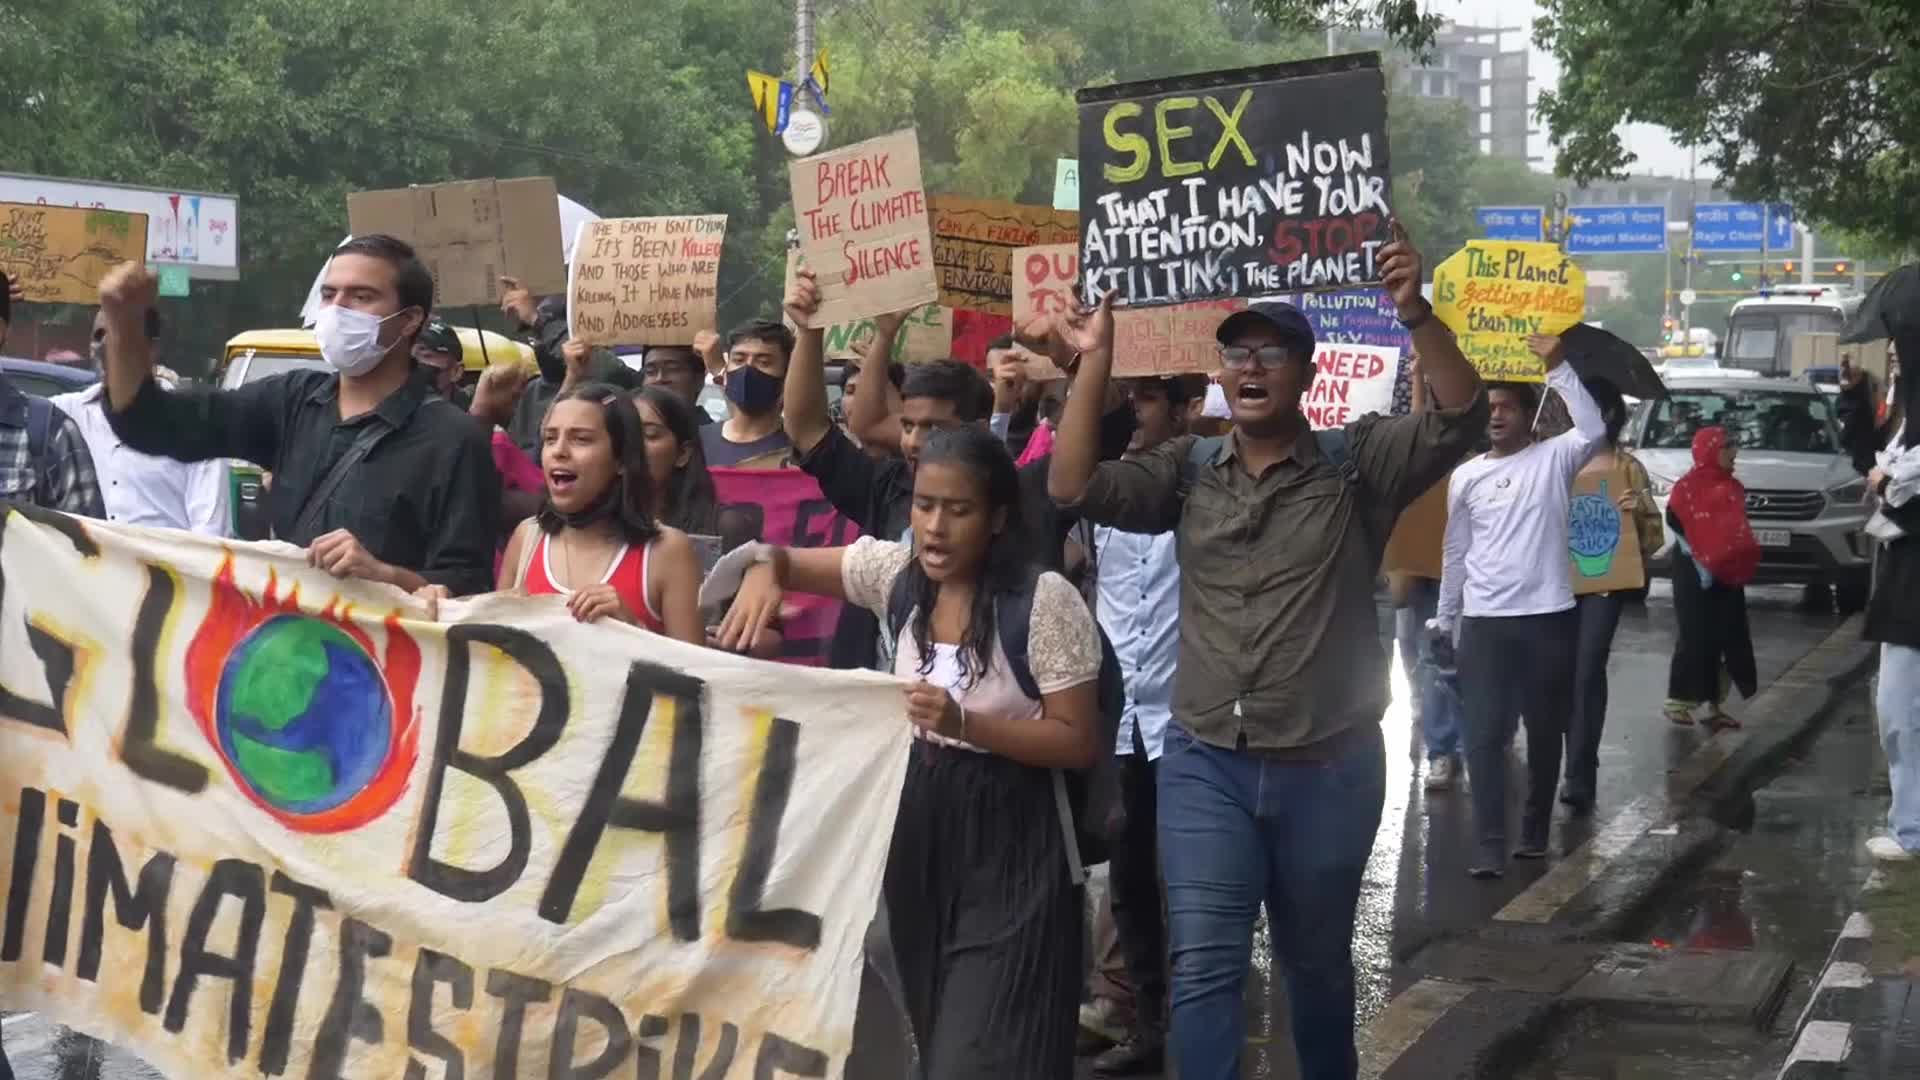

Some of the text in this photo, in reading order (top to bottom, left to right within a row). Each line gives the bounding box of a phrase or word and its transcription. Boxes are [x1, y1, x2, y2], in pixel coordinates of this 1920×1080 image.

[1103, 89, 1257, 184] SEX
[1286, 131, 1372, 177] NOW
[817, 155, 892, 206] BREAK
[1097, 171, 1390, 227] THAT I HAVE YOUR
[592, 221, 612, 235] THE
[620, 221, 657, 235] EARTH
[804, 191, 924, 240] THE CLIMATE
[631, 235, 677, 259] BEEN
[1082, 212, 1379, 265] ATTENTION, STOP
[578, 260, 716, 282] AND THOSE WHO ARE
[842, 239, 921, 286] SILENCE
[1243, 261, 1281, 289] THE
[1287, 240, 1382, 286] PLANET
[1466, 247, 1569, 284] This Planet
[650, 284, 682, 300] HAVE
[1302, 293, 1376, 311] POLLUTION
[1438, 271, 1456, 304] is
[1456, 279, 1532, 315] getting
[577, 310, 689, 332] AND ADDRESSES
[1466, 306, 1543, 335] than my
[1317, 351, 1385, 379] NEED
